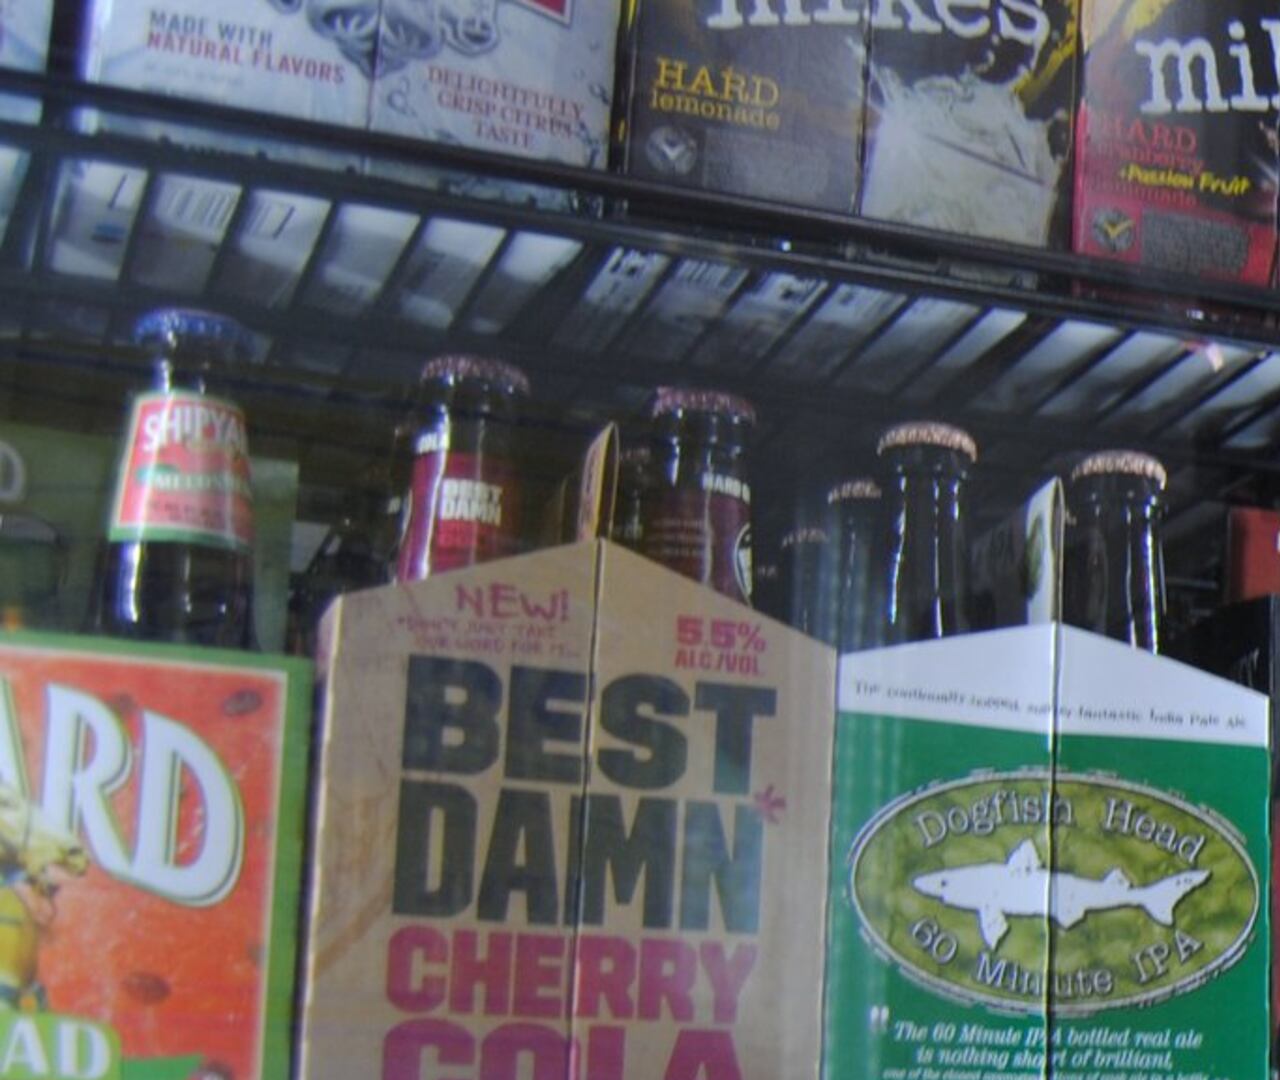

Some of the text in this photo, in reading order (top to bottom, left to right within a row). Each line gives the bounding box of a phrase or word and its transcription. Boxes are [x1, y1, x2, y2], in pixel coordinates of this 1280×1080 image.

[150, 11, 273, 49] MADE WITH
[147, 34, 247, 67] NATURAL
[251, 49, 346, 84] FLAVORS
[655, 57, 780, 109] HARD
[427, 66, 584, 120] DELIGHTFULLY
[436, 93, 575, 137] CRISP CITRUS
[650, 90, 780, 131] lemonade
[473, 122, 534, 150] TASTE
[142, 405, 251, 454] SHIPYA
[455, 582, 570, 622] NEW!
[674, 613, 768, 653] 5.5%
[402, 657, 777, 794] BEST
[912, 788, 1207, 865] Dogfish Head
[391, 780, 763, 935] DAMN
[386, 925, 758, 1026] CHERRY
[910, 917, 1205, 997] 60 Minute IPA
[894, 1019, 929, 1042] The
[932, 1022, 957, 1043] 60
[958, 1023, 1022, 1047] Minute
[1066, 1027, 1131, 1049] bottled
[1134, 1028, 1172, 1049] real
[1174, 1029, 1204, 1049] ale
[937, 1047, 1011, 1071] nothing
[1071, 1049, 1093, 1068] of
